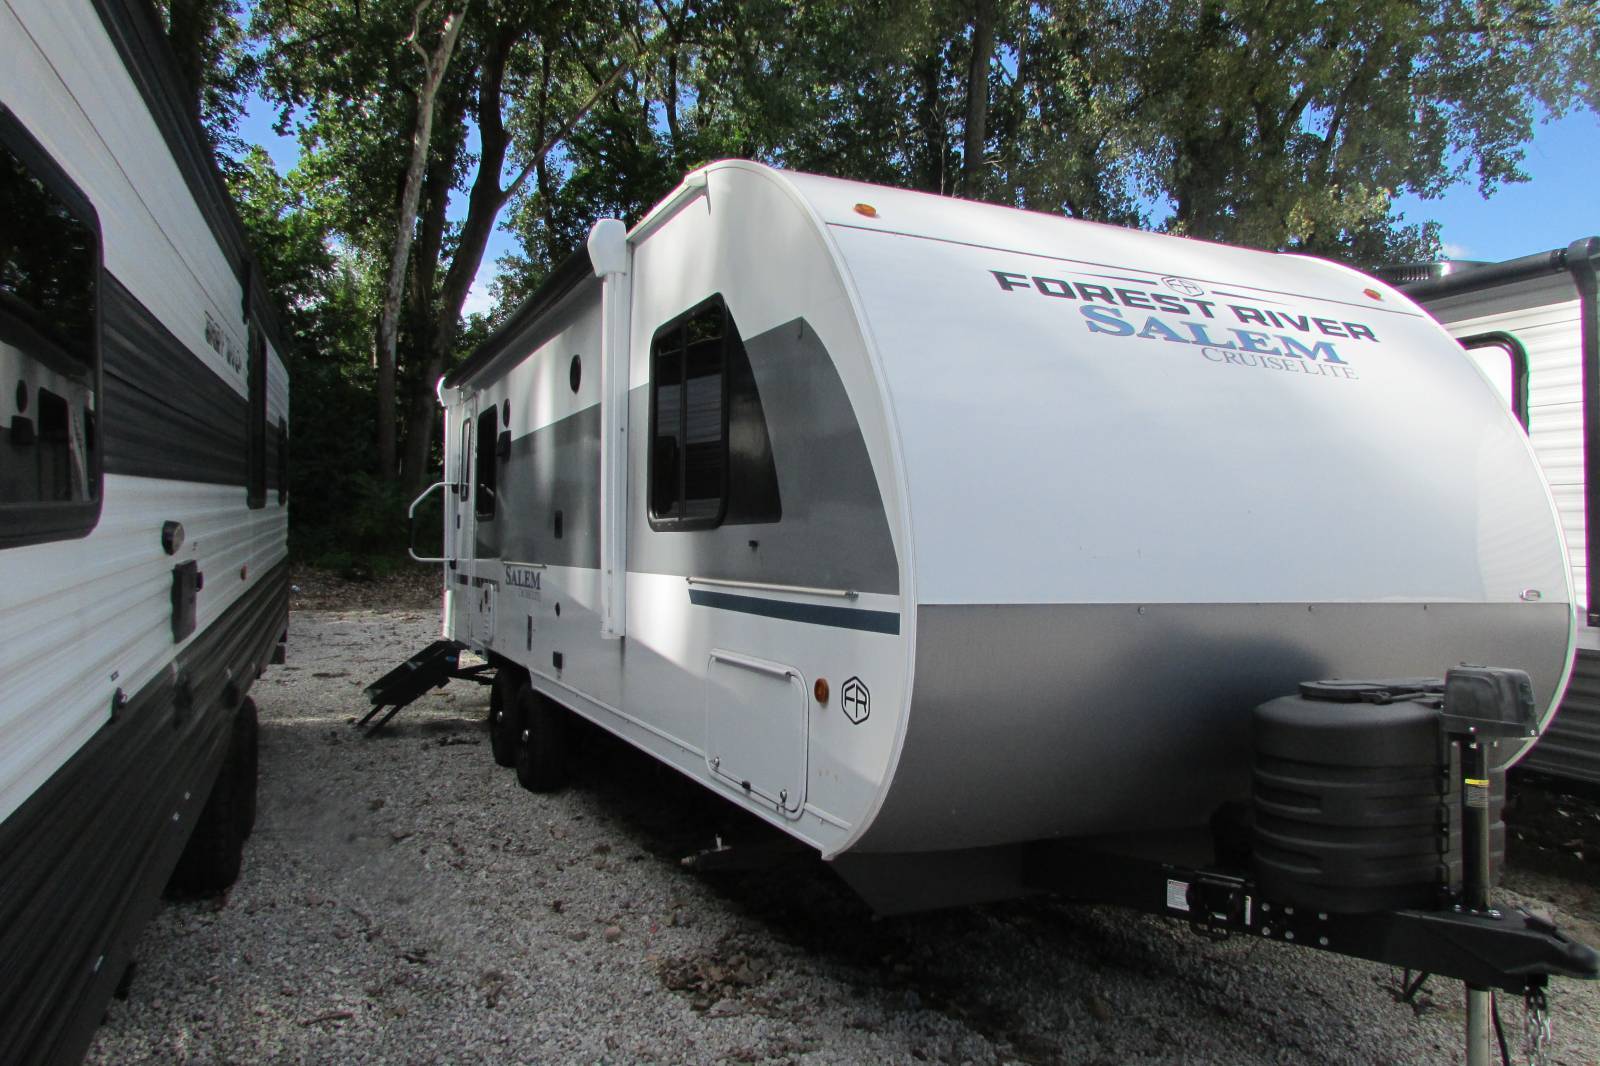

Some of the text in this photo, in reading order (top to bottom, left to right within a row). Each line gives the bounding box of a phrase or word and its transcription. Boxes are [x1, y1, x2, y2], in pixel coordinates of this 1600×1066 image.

[987, 270, 1381, 342] FOREST RIVER
[1079, 304, 1349, 366] SALEM
[505, 565, 542, 590] SALEM
